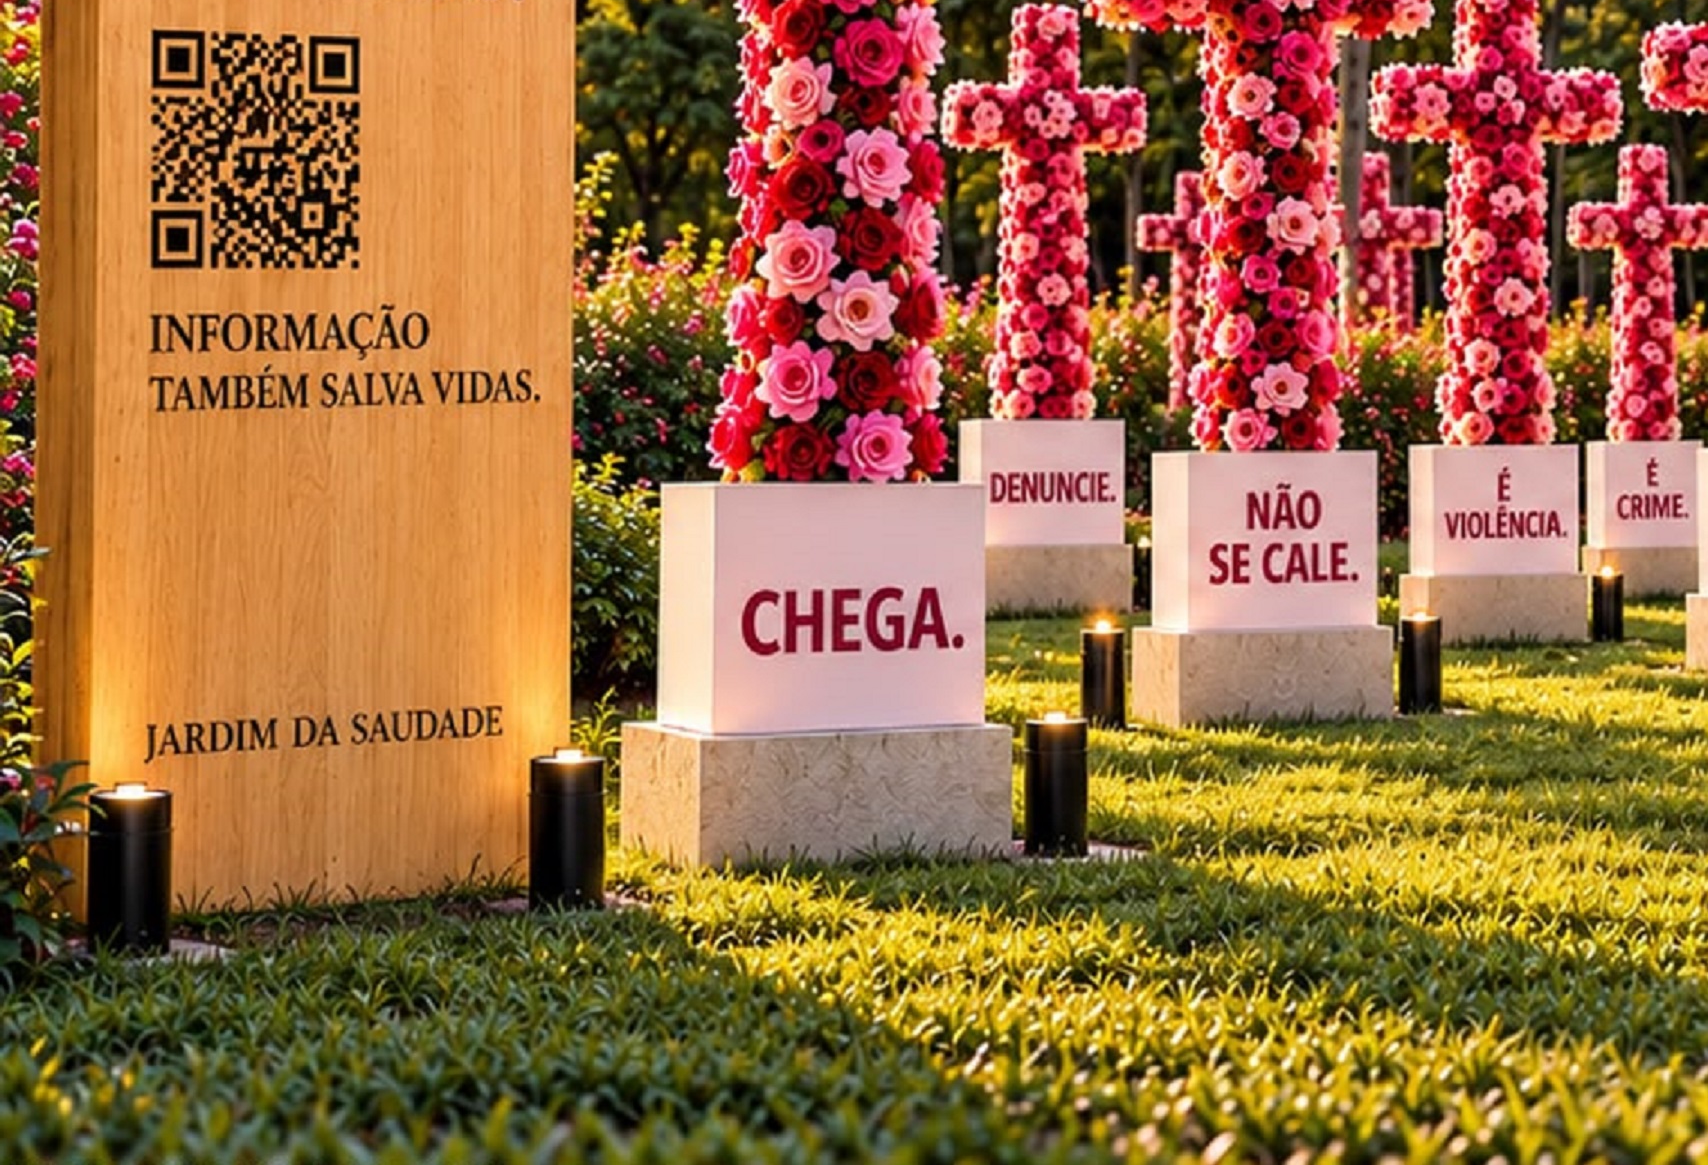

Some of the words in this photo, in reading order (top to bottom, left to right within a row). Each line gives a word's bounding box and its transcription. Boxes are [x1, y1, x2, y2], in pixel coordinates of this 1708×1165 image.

[150, 304, 431, 361] INFORMAÇÃO
[148, 364, 309, 413] TAMBÉM
[320, 372, 425, 409] SALVA
[431, 368, 541, 404] VIDAS.
[990, 471, 1117, 503] DENUNCIE.
[1497, 466, 1511, 503] É
[1646, 457, 1659, 487] É
[1246, 483, 1322, 530] NÃO
[1444, 505, 1567, 540] VIOLÊNCIA.
[1616, 493, 1689, 521] CRIME.
[1209, 543, 1251, 586] SE
[1262, 542, 1359, 584] CALE.
[741, 587, 964, 656] CHEGA.
[144, 717, 278, 764] JARDIM
[292, 715, 341, 748] DA
[350, 705, 503, 746] SAUDADE
